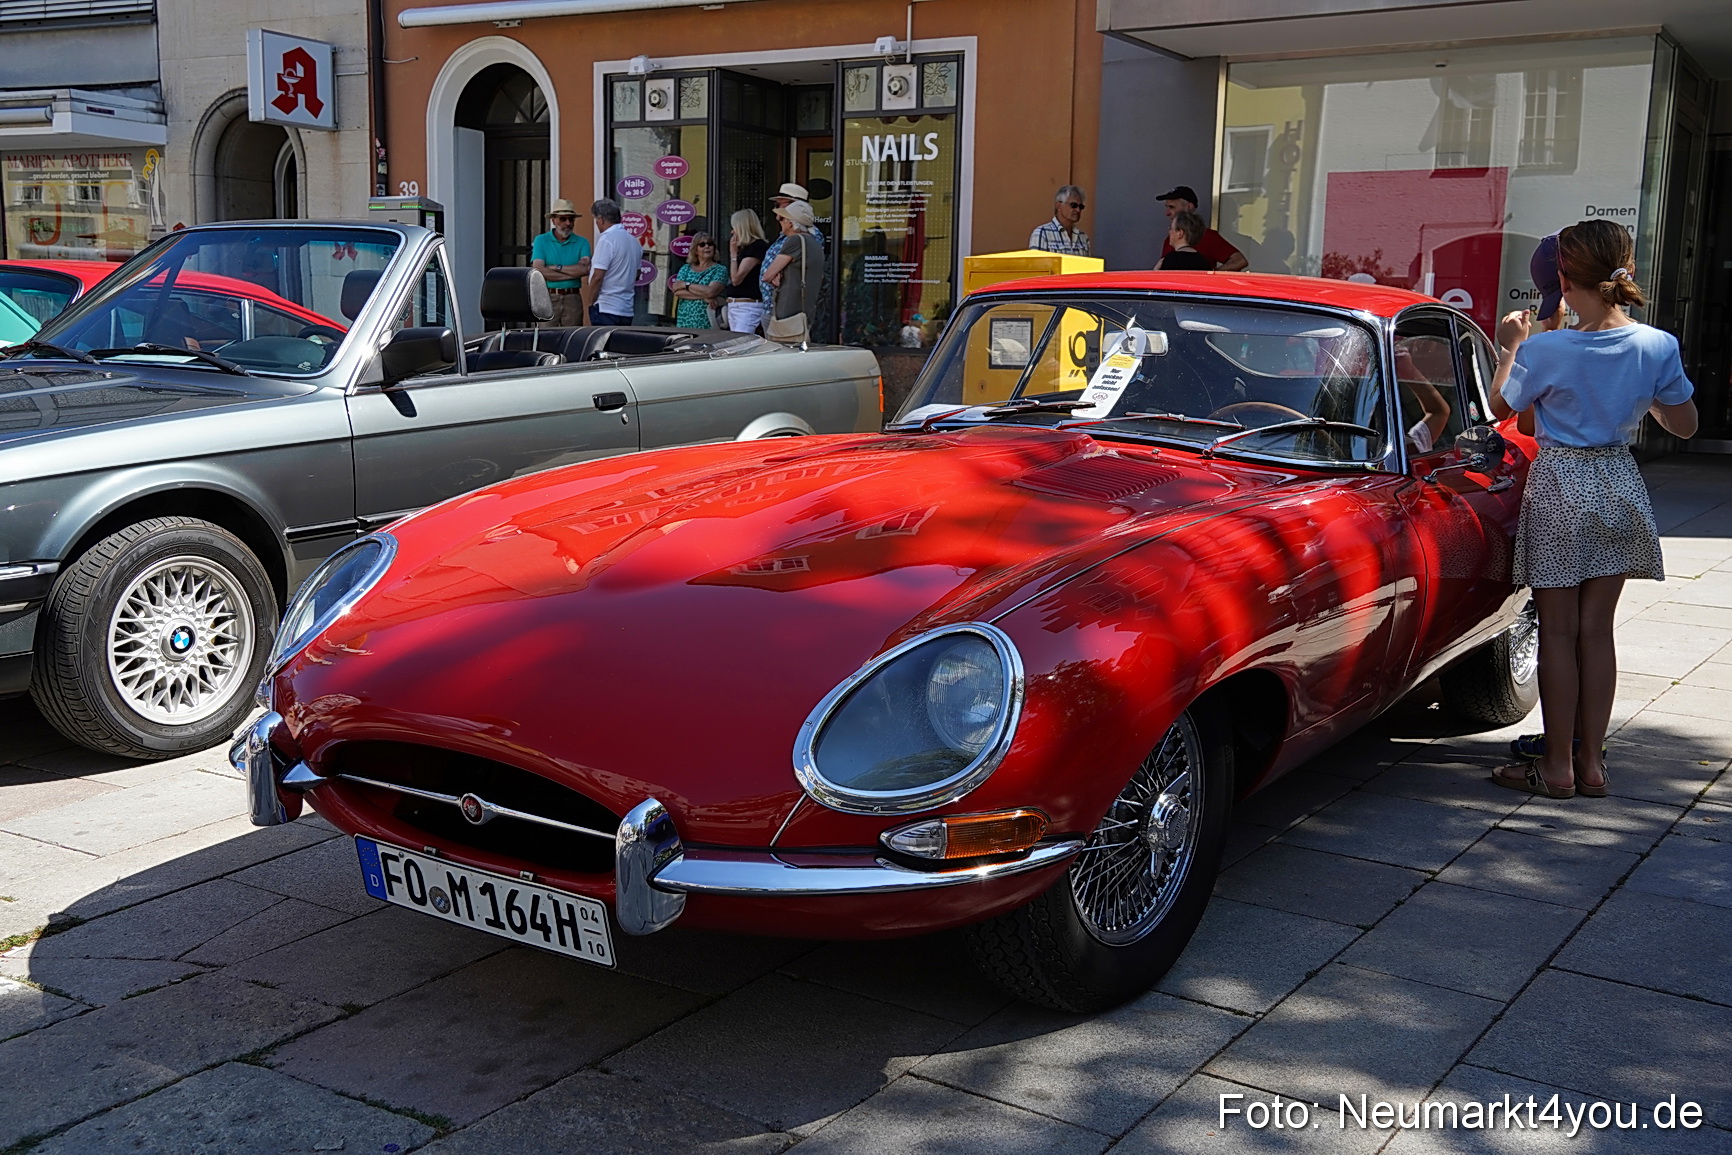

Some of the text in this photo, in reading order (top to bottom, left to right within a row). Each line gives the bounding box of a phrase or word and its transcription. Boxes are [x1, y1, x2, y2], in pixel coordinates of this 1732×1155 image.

[862, 132, 938, 162] NAILS
[6, 153, 132, 168] MARIEN APOTHEKE
[51, 172, 70, 180] werden,
[624, 179, 645, 188] Nails
[399, 181, 419, 197] 39
[1586, 206, 1636, 216] Damen
[1509, 289, 1543, 300] Onlin
[370, 874, 379, 887] D
[381, 852, 428, 906] FO
[580, 906, 599, 923] 04
[587, 940, 605, 956] 10
